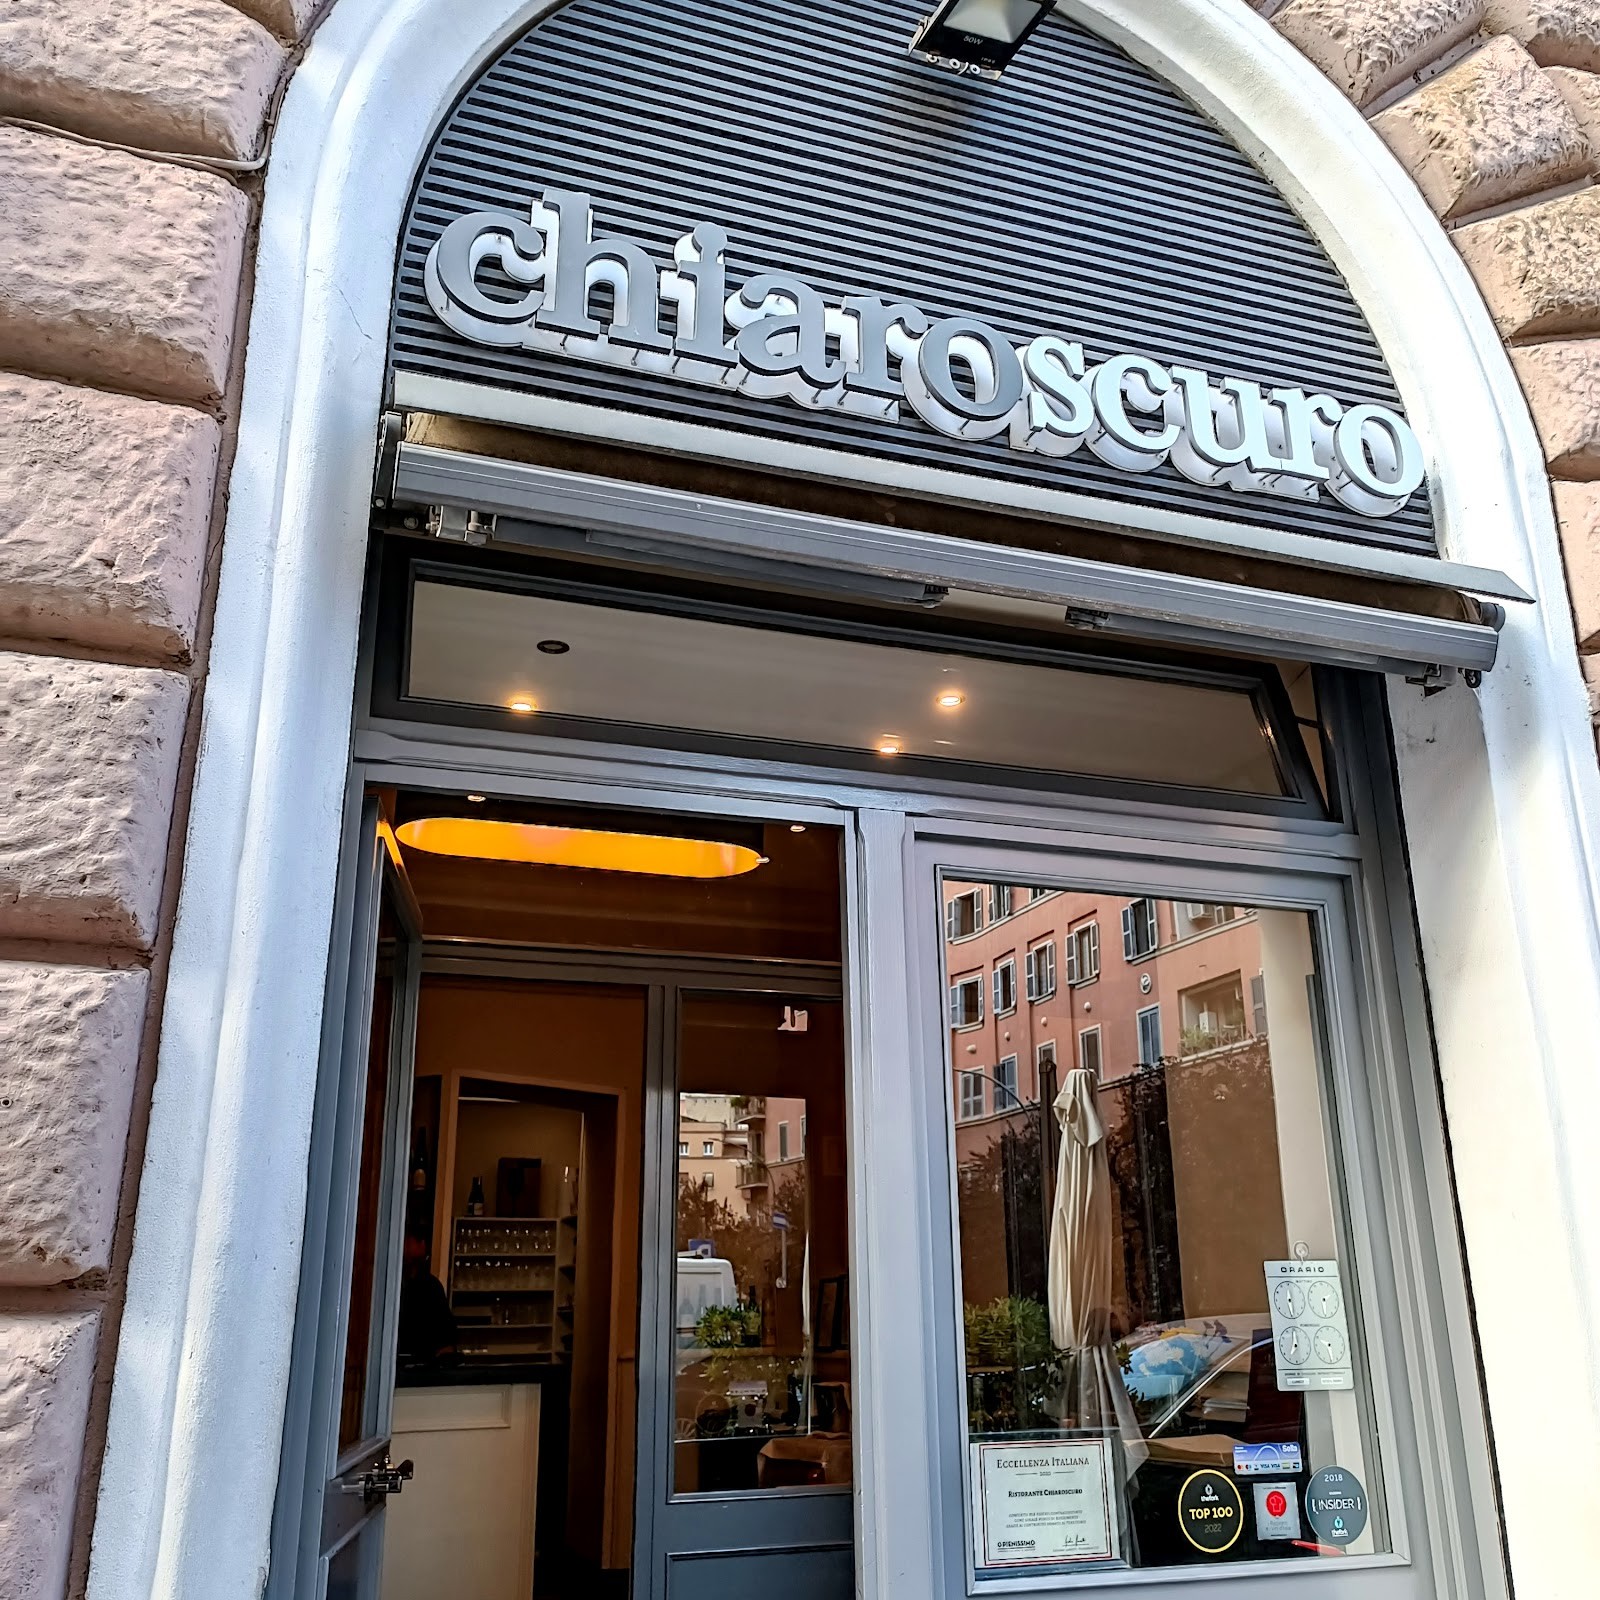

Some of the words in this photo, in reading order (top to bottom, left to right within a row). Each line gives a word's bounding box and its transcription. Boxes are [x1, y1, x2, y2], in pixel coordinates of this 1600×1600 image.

[423, 187, 1425, 518] chiaroscuro
[1324, 1473, 1343, 1482] 2018
[1318, 1498, 1355, 1510] INSIDER
[1189, 1508, 1210, 1520] TOP
[1212, 1506, 1234, 1519] 100
[1204, 1523, 1222, 1534] 2022
